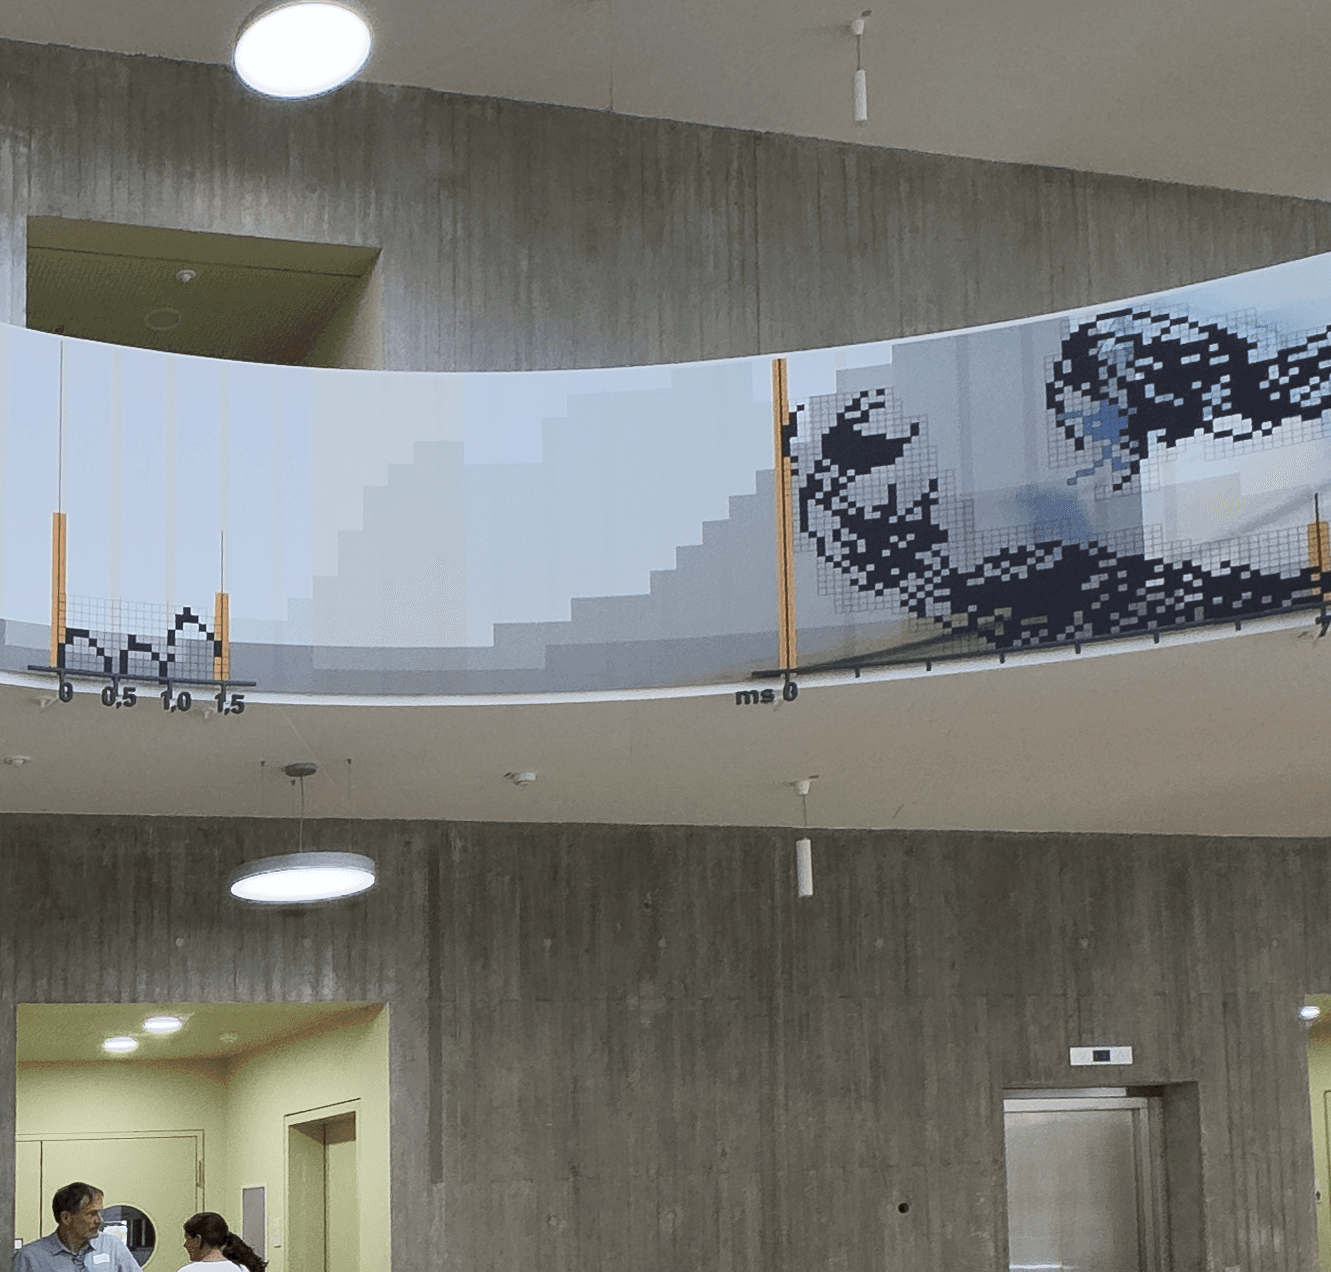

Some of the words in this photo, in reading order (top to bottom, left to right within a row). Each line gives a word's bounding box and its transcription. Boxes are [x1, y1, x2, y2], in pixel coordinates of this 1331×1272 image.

[58, 681, 73, 703] 0
[101, 685, 137, 709] 0,5
[160, 690, 192, 713] 1,0
[214, 691, 245, 715] 1,5
[735, 688, 775, 705] ms
[783, 682, 798, 701] 0
